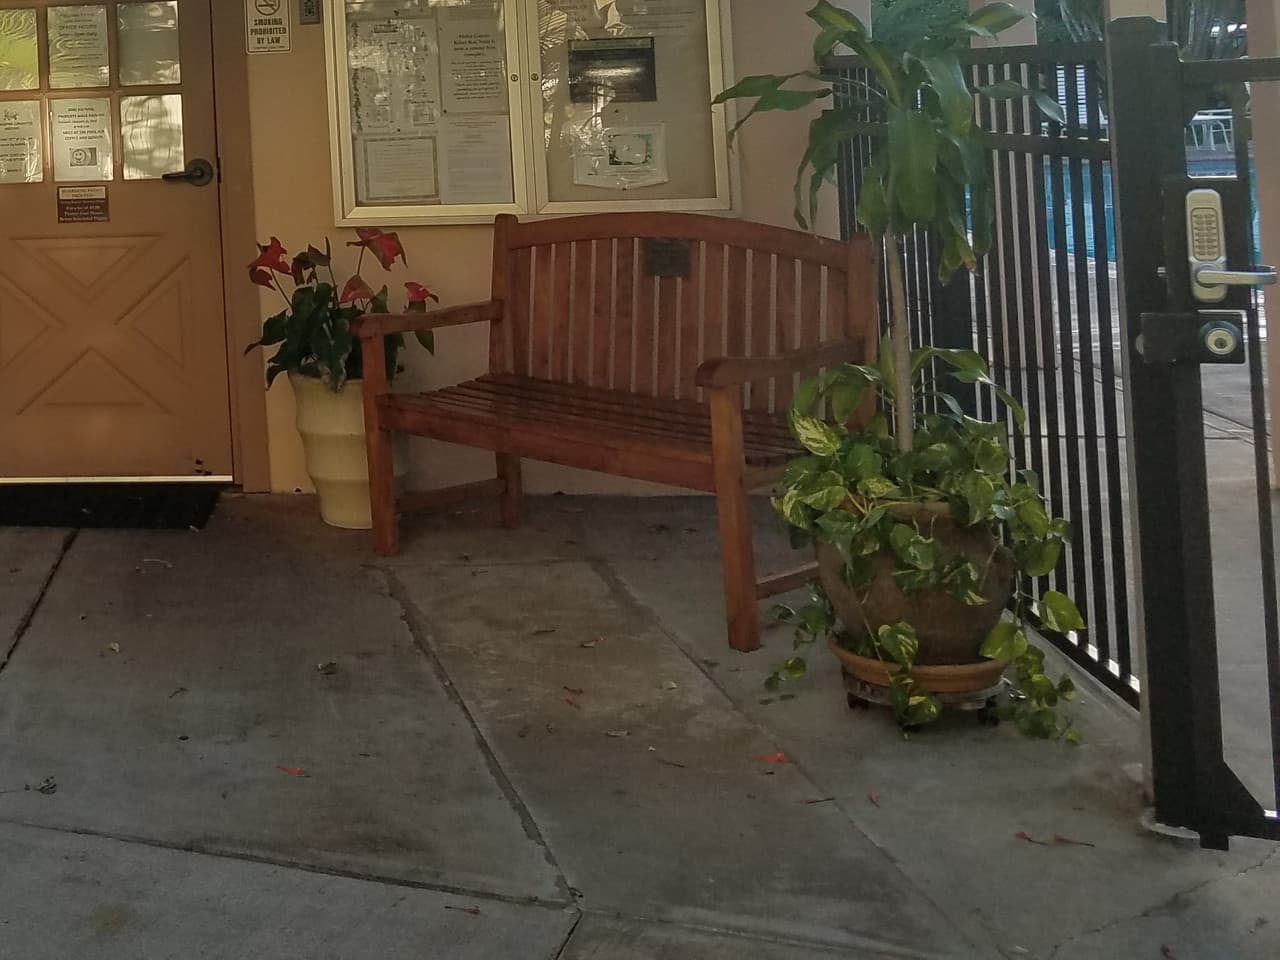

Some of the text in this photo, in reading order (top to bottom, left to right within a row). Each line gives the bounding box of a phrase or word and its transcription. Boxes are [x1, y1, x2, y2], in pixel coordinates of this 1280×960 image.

[254, 18, 283, 26] SMOKING
[250, 27, 287, 36] PROHIBITED
[256, 36, 281, 45] BY LAW
